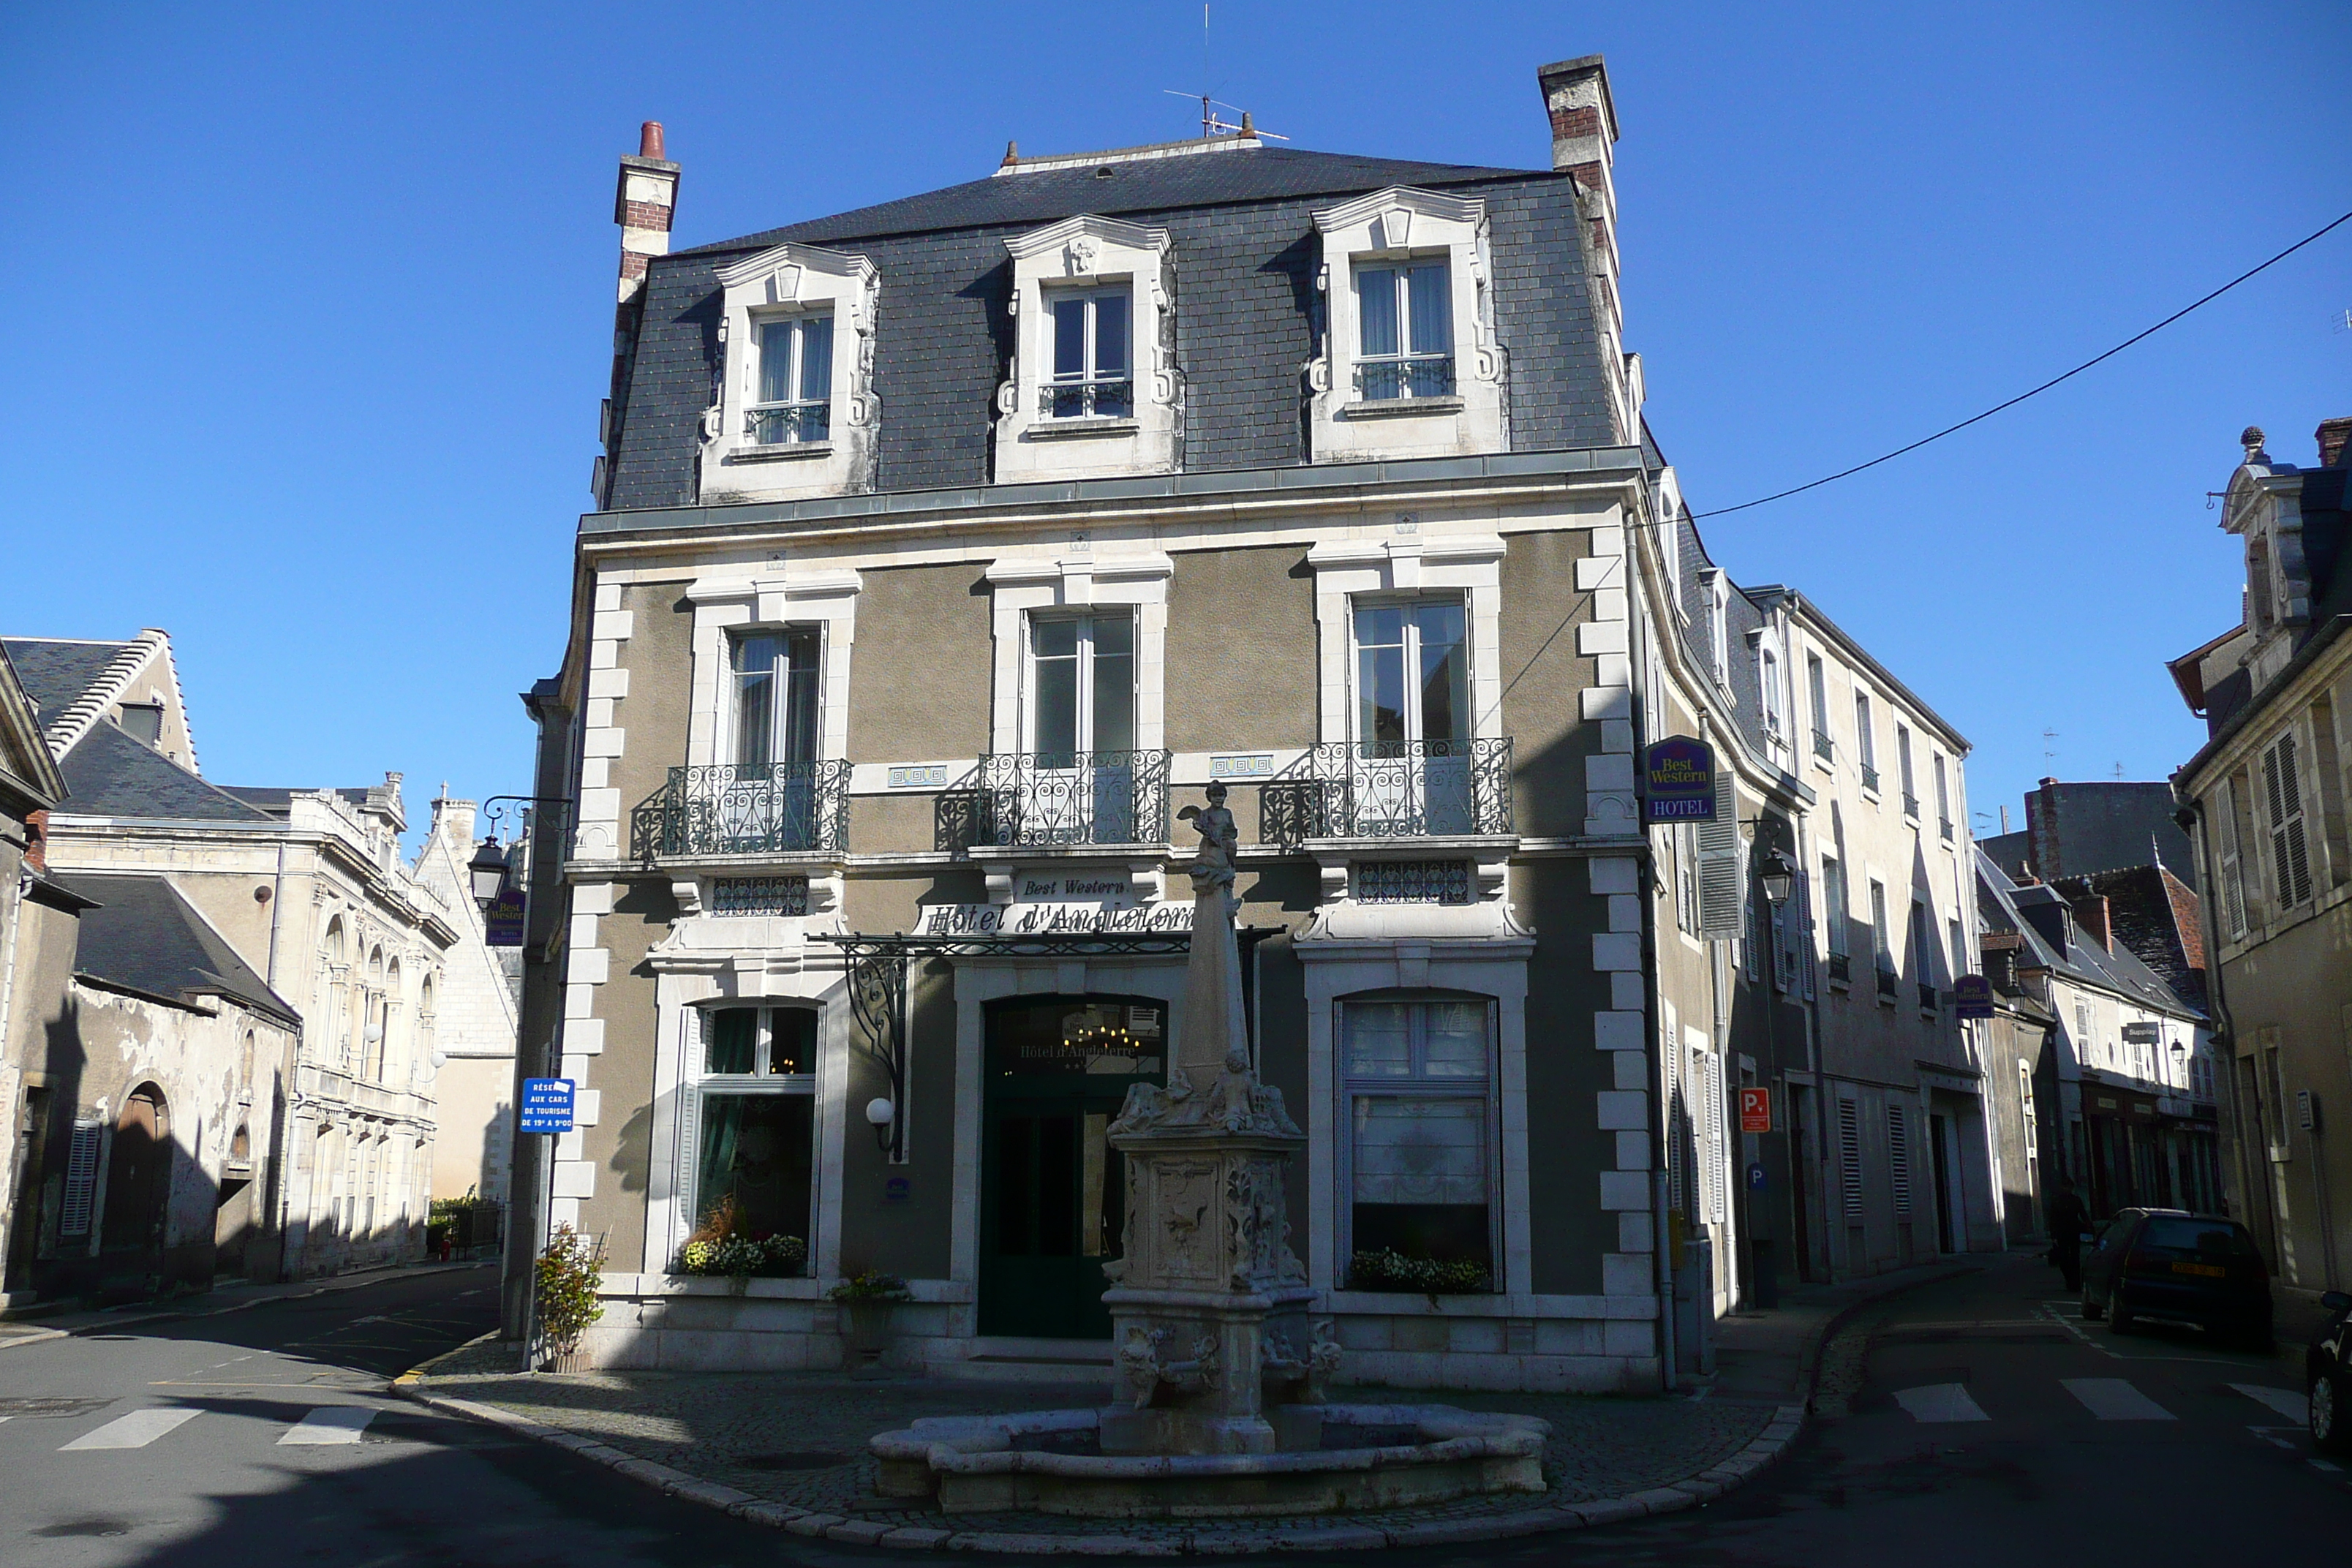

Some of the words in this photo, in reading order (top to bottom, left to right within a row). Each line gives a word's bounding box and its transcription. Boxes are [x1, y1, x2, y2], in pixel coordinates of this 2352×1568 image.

[1662, 758, 1694, 772] Best
[1651, 770, 1708, 783] Western
[1654, 800, 1708, 815] HOTEL
[1025, 881, 1057, 895] Best
[500, 903, 520, 912] Best
[491, 911, 524, 920] Wester
[930, 905, 1006, 931] Hôtel
[1020, 1045, 1053, 1058] Hôtel
[1744, 1093, 1758, 1112] P
[1752, 1170, 1763, 1184] P
